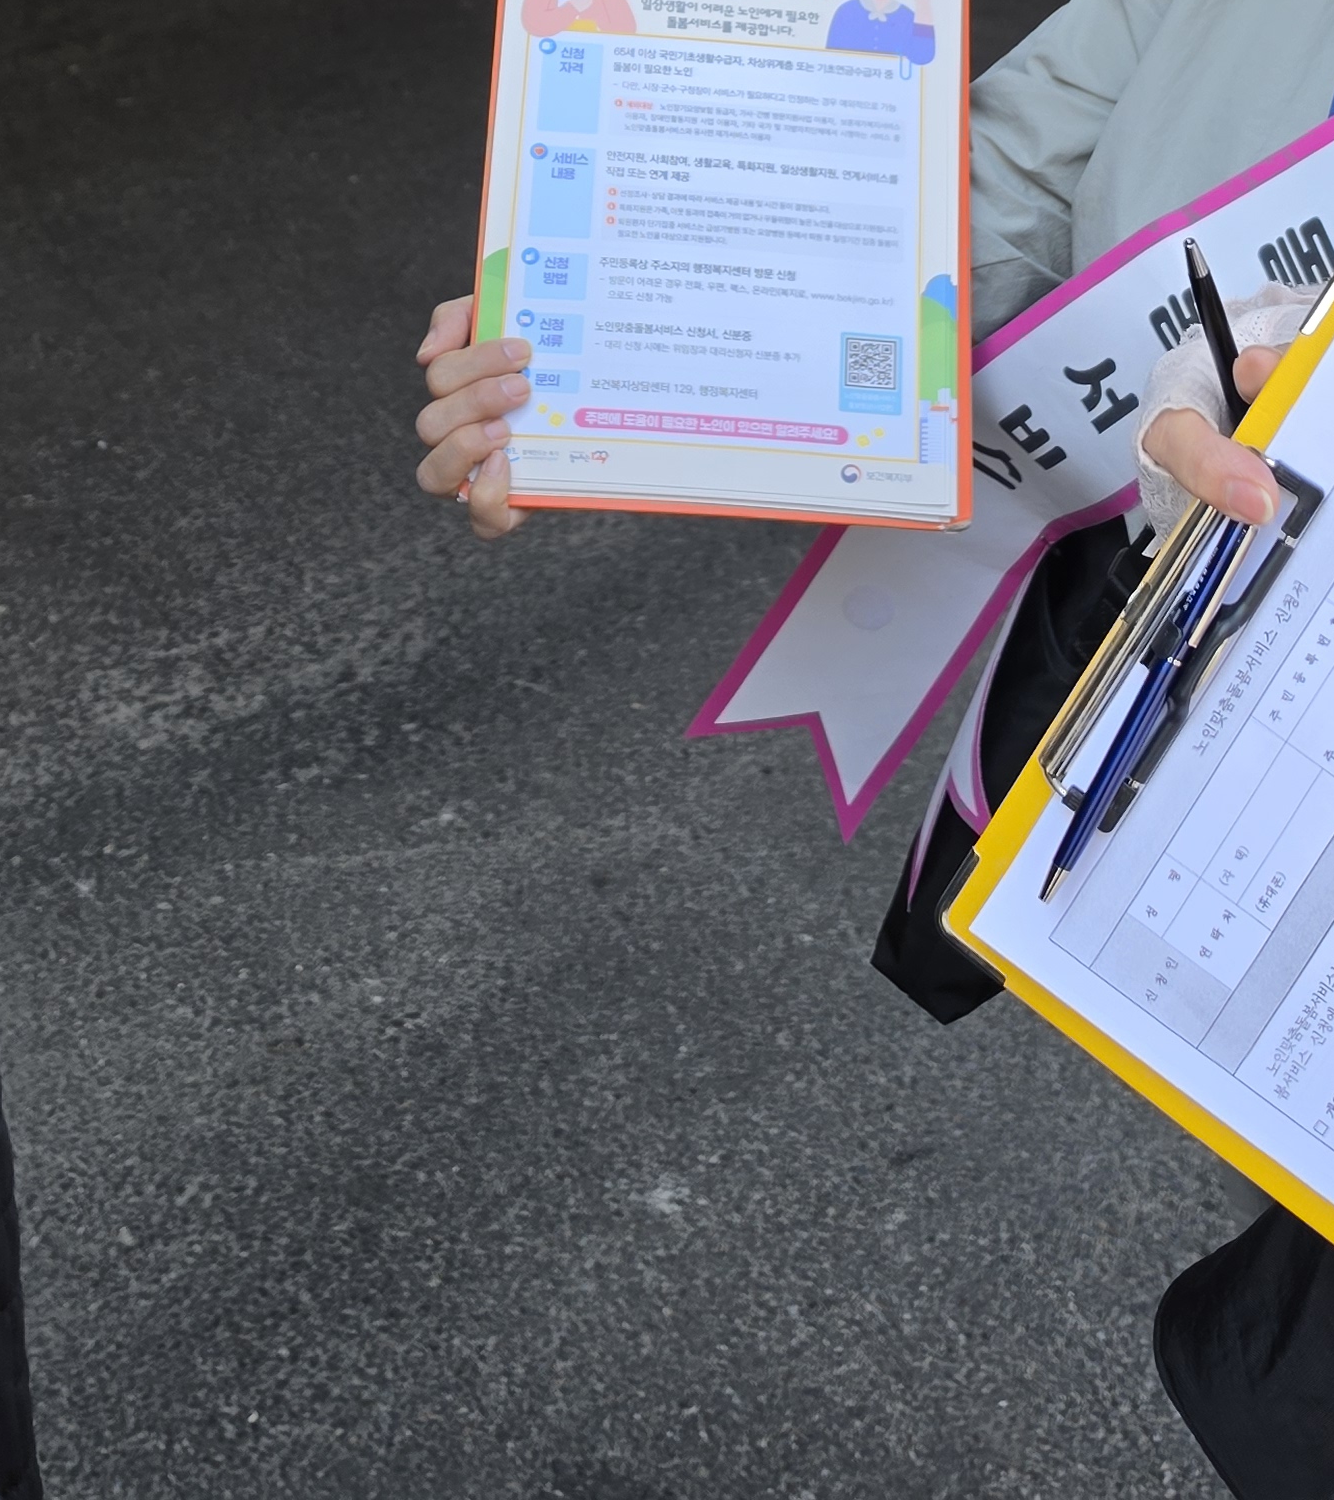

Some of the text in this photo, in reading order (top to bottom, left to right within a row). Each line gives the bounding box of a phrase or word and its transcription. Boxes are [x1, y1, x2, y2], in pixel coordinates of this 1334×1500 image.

[700, 2, 734, 16] 어려운
[737, 5, 782, 19] 노인에게
[785, 9, 819, 24] 필요한
[666, 16, 795, 37] 돌봄서비스를 제공합니다.
[560, 46, 584, 59] 신청
[559, 61, 583, 74] 자격
[612, 62, 693, 77] 돌봄이 필요한 노인
[552, 151, 589, 165] 서비스
[550, 167, 575, 179] 내용
[605, 166, 690, 181] 직접 또는 연계 제공
[544, 256, 568, 269] 신청
[599, 257, 796, 281] 주민등록상 주소지의 행정복지센터 방문 신청
[543, 271, 567, 285] 방법
[539, 318, 564, 331] 신청
[594, 320, 752, 341] 노인맞춤돌봄서비스 신청서, 신분증
[538, 333, 563, 347] 서류
[535, 373, 560, 387] 문의
[1187, 625, 1282, 757] 노인맞춤돌봄서비스
[1270, 577, 1310, 626] 신청서
